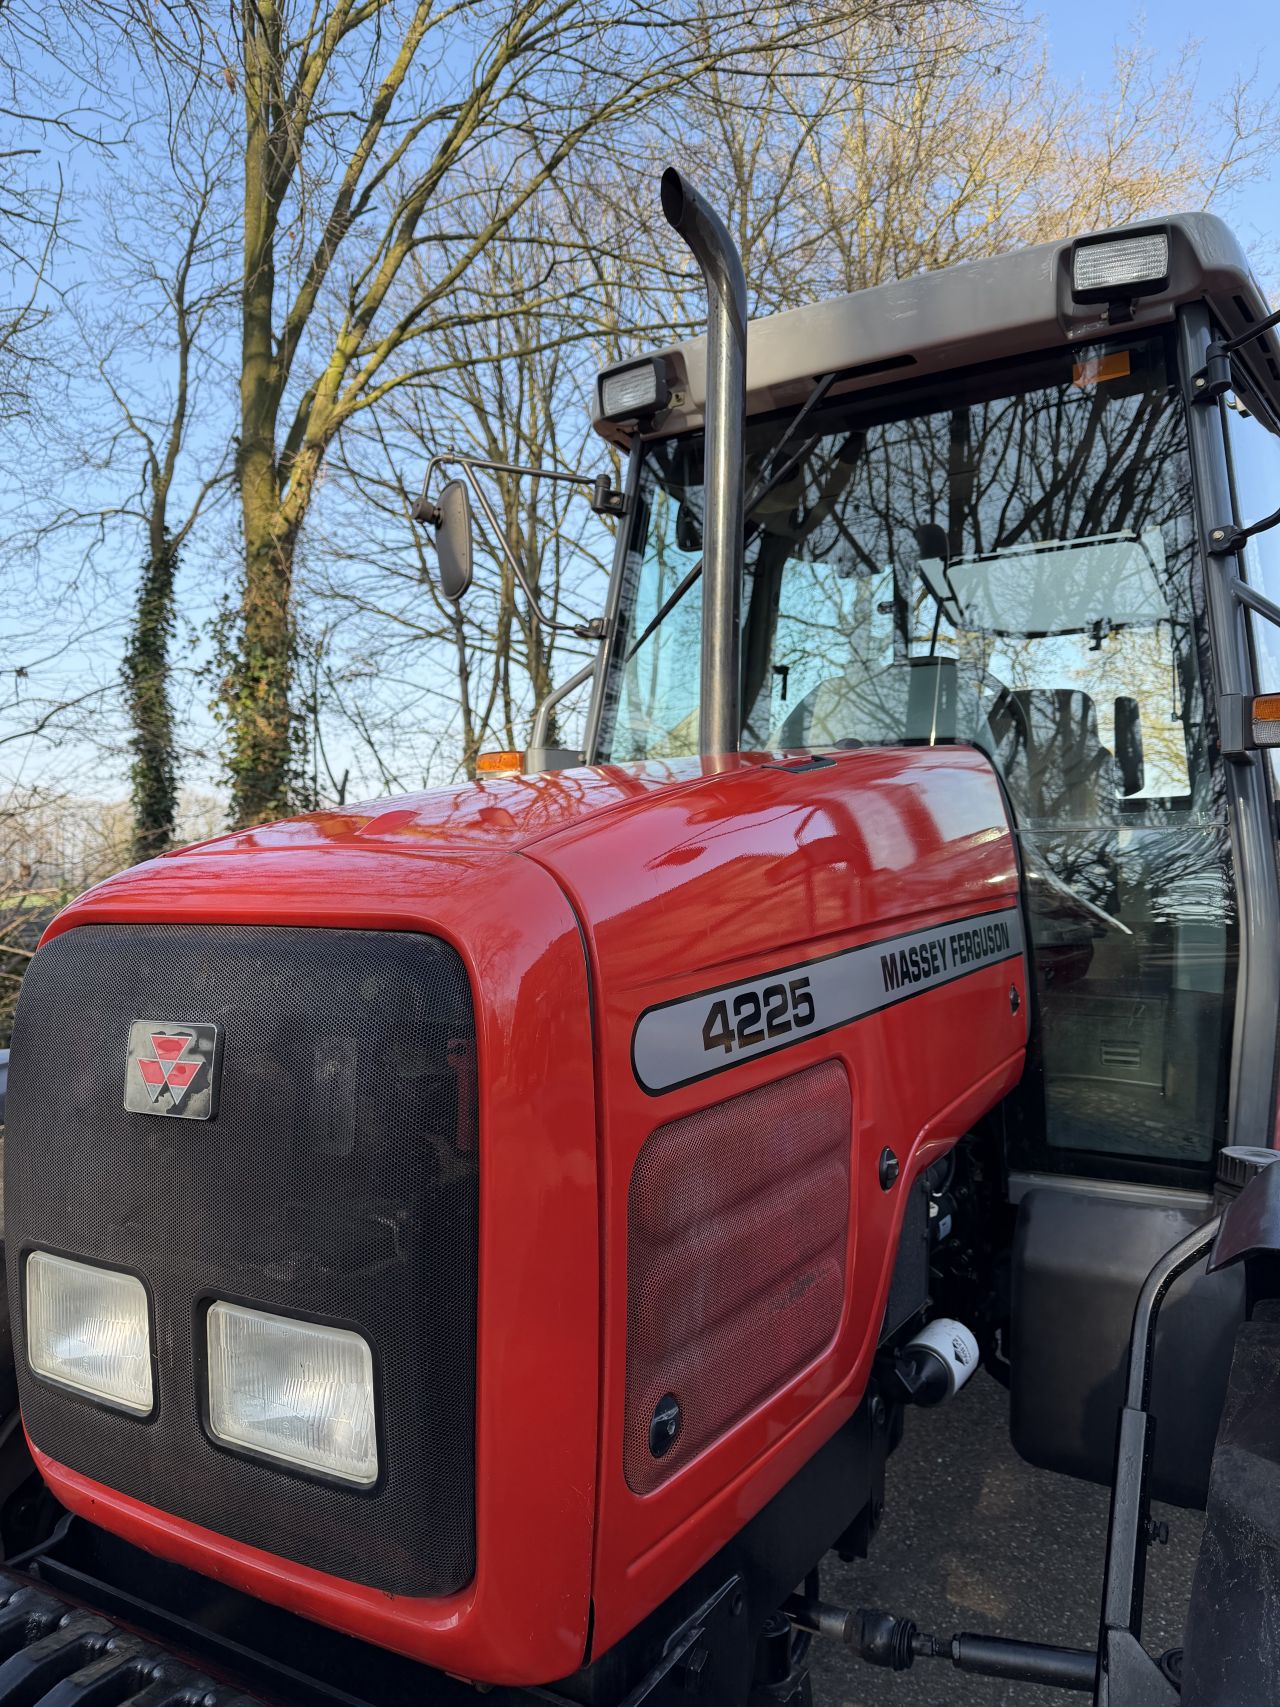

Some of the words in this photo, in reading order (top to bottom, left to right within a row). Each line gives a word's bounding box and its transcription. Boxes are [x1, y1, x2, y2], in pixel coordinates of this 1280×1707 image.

[880, 938, 947, 992] MASSEY
[949, 922, 1010, 967] FERGUSON
[702, 976, 815, 1054] 4225
